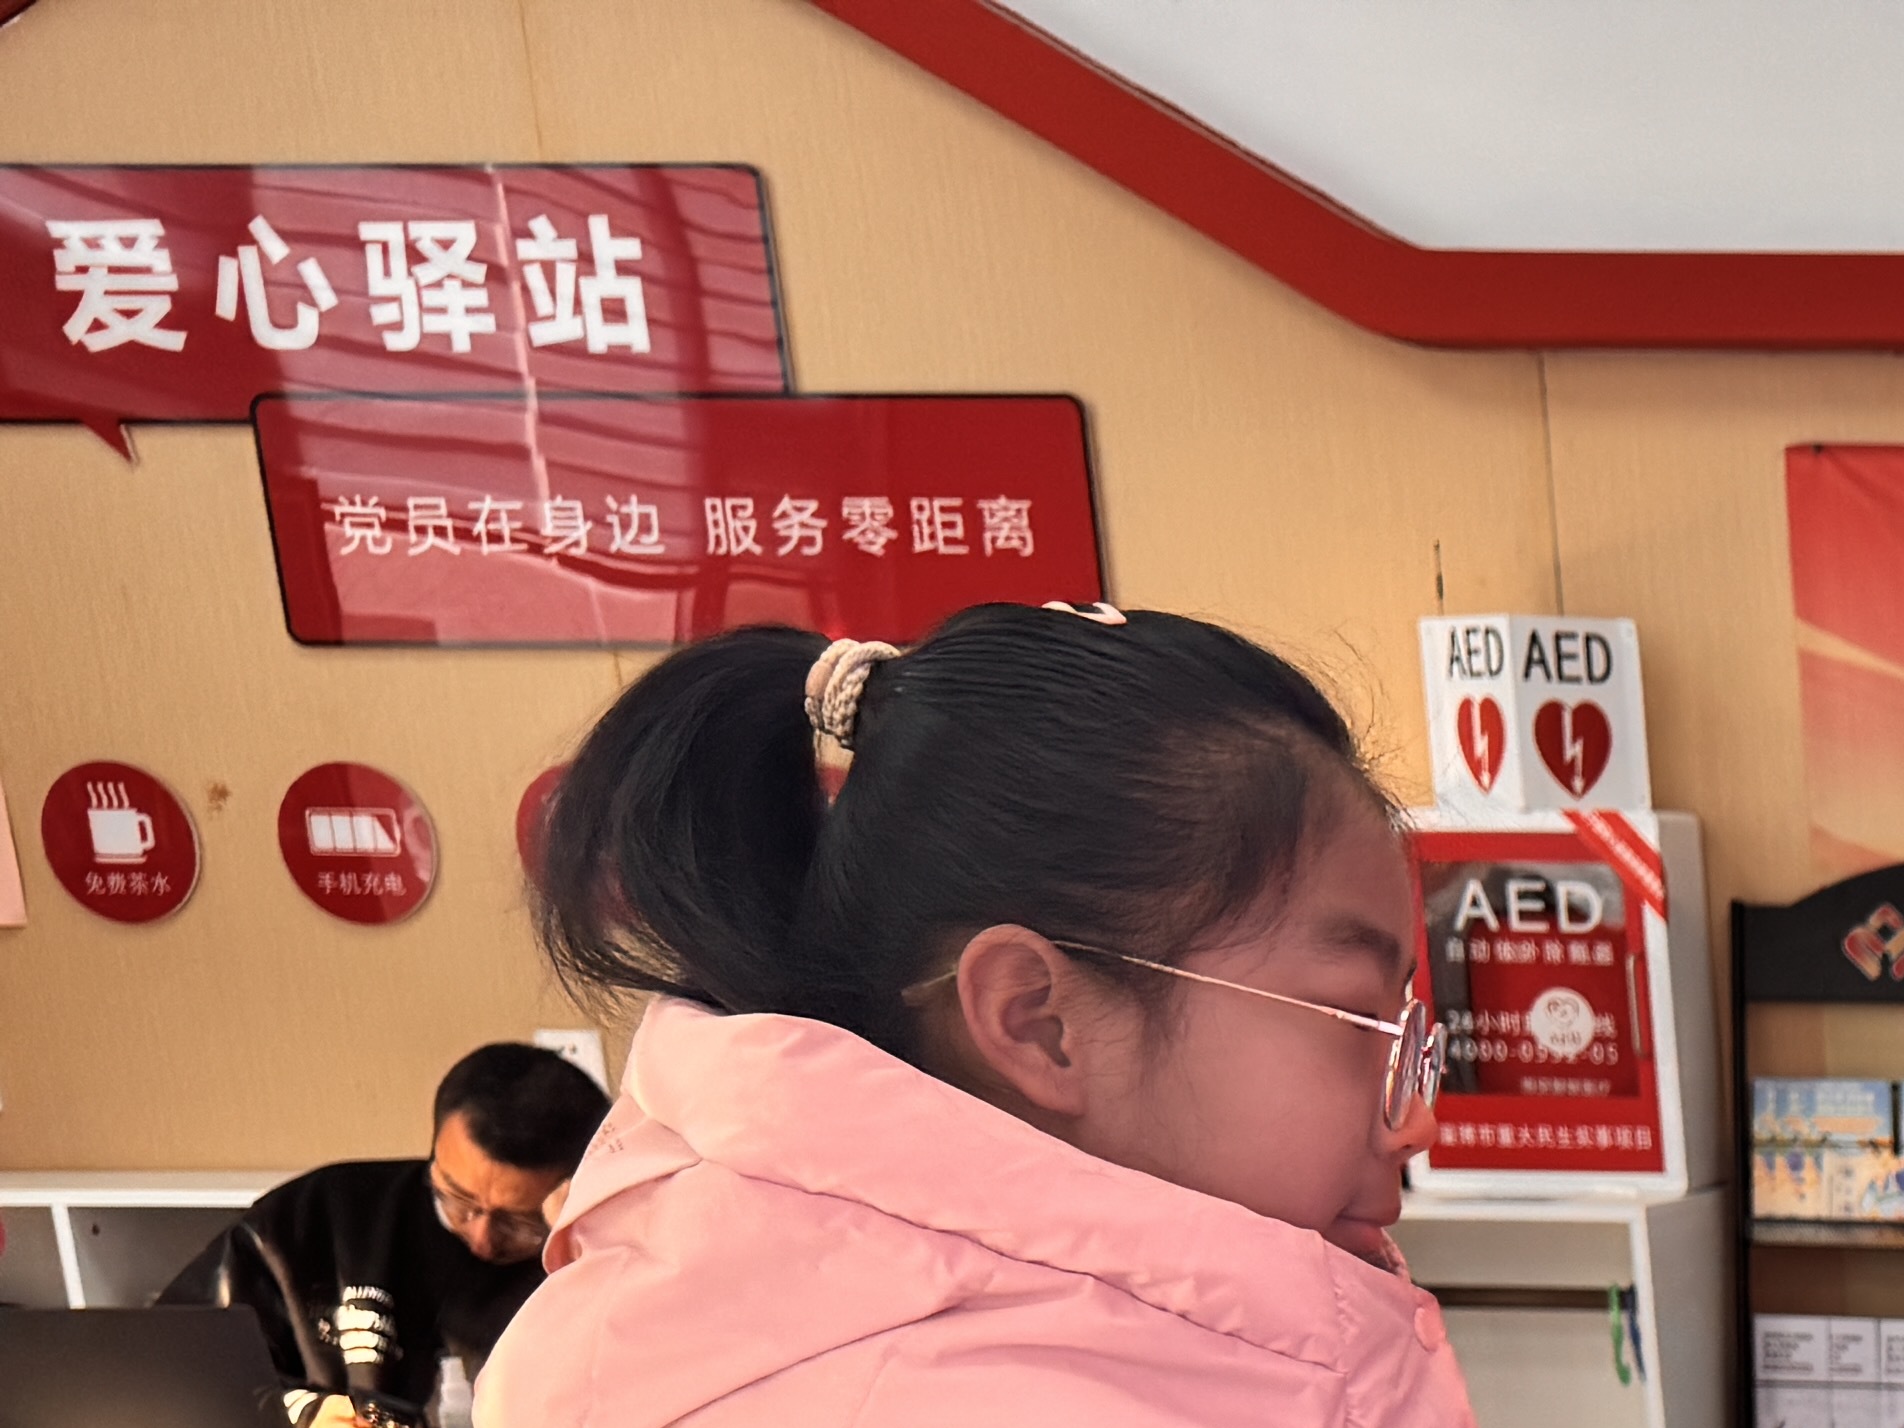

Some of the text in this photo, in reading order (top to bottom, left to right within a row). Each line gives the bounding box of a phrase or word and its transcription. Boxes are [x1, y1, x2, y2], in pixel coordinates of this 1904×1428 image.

[44, 213, 653, 356] 爱心驿站
[332, 494, 1036, 558] 党员在身边 服务零距离
[1449, 625, 1505, 678] AED
[1523, 628, 1613, 684] AED
[85, 870, 172, 897] 免费茶水
[316, 870, 407, 898] 手机充电
[1454, 878, 1604, 934] AED
[1447, 1010, 1618, 1038] 24小时线
